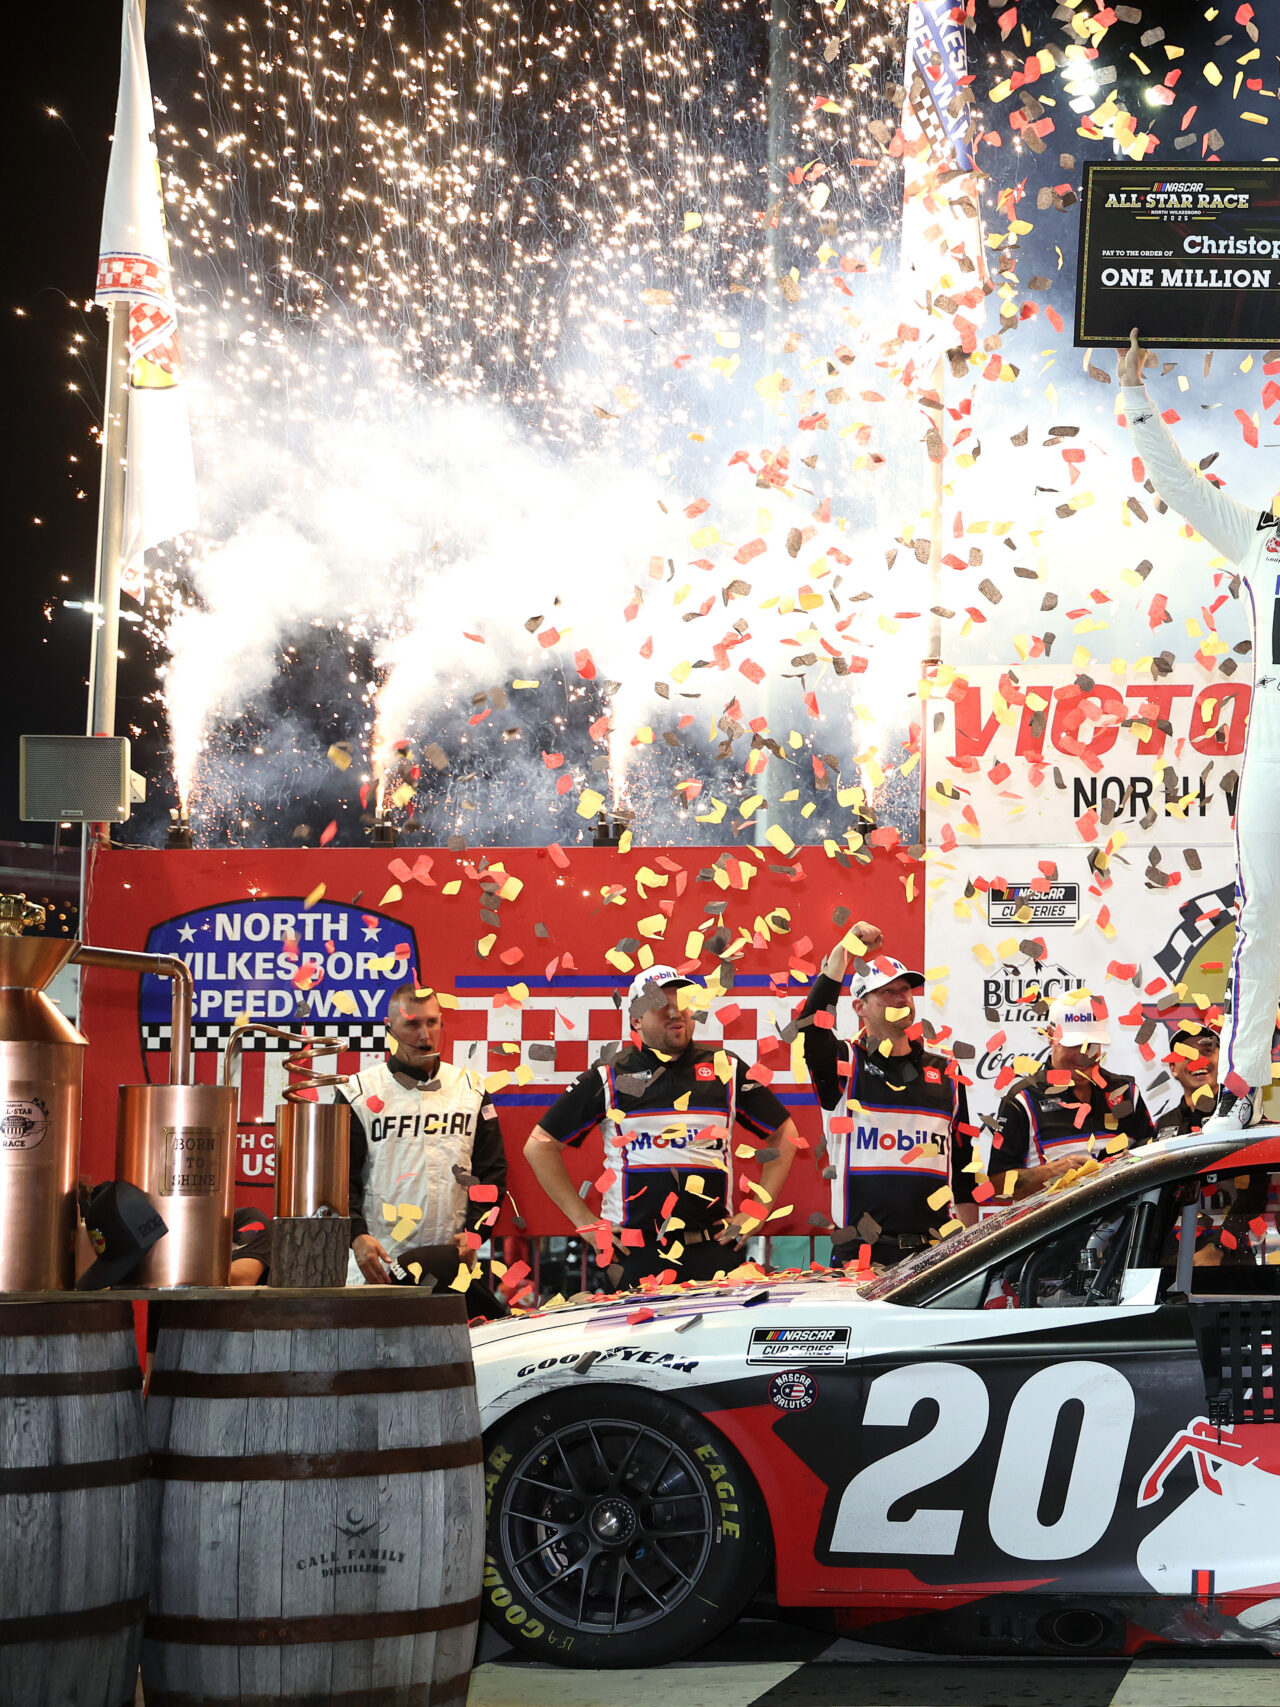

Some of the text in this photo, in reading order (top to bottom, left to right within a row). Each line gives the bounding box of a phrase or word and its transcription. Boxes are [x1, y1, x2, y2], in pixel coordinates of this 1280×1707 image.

[1165, 183, 1203, 192] NASCAR
[1198, 194, 1249, 208] RACE
[1101, 268, 1153, 287] ONE
[1161, 269, 1272, 288] MILLION
[948, 683, 1254, 756] VICTO
[1017, 887, 1066, 901] NASCAR
[214, 912, 349, 942] NORTH
[156, 951, 409, 981] WILKESBORO
[1064, 1012, 1092, 1023] Mobil
[371, 1112, 473, 1143] OFFICIAL
[174, 1138, 215, 1151] BORN
[856, 1126, 928, 1151] Mobil
[186, 1157, 205, 1169] TO
[171, 1174, 216, 1187] SHINE
[783, 1330, 836, 1341] NASCAR
[763, 1345, 834, 1356] CUP SERIES
[774, 1371, 812, 1387] NASCAR
[773, 1394, 813, 1410] SALUTES
[829, 1360, 1136, 1561] 20
[694, 1443, 740, 1540] EAGLE
[297, 1549, 406, 1570] CALL FAMILY
